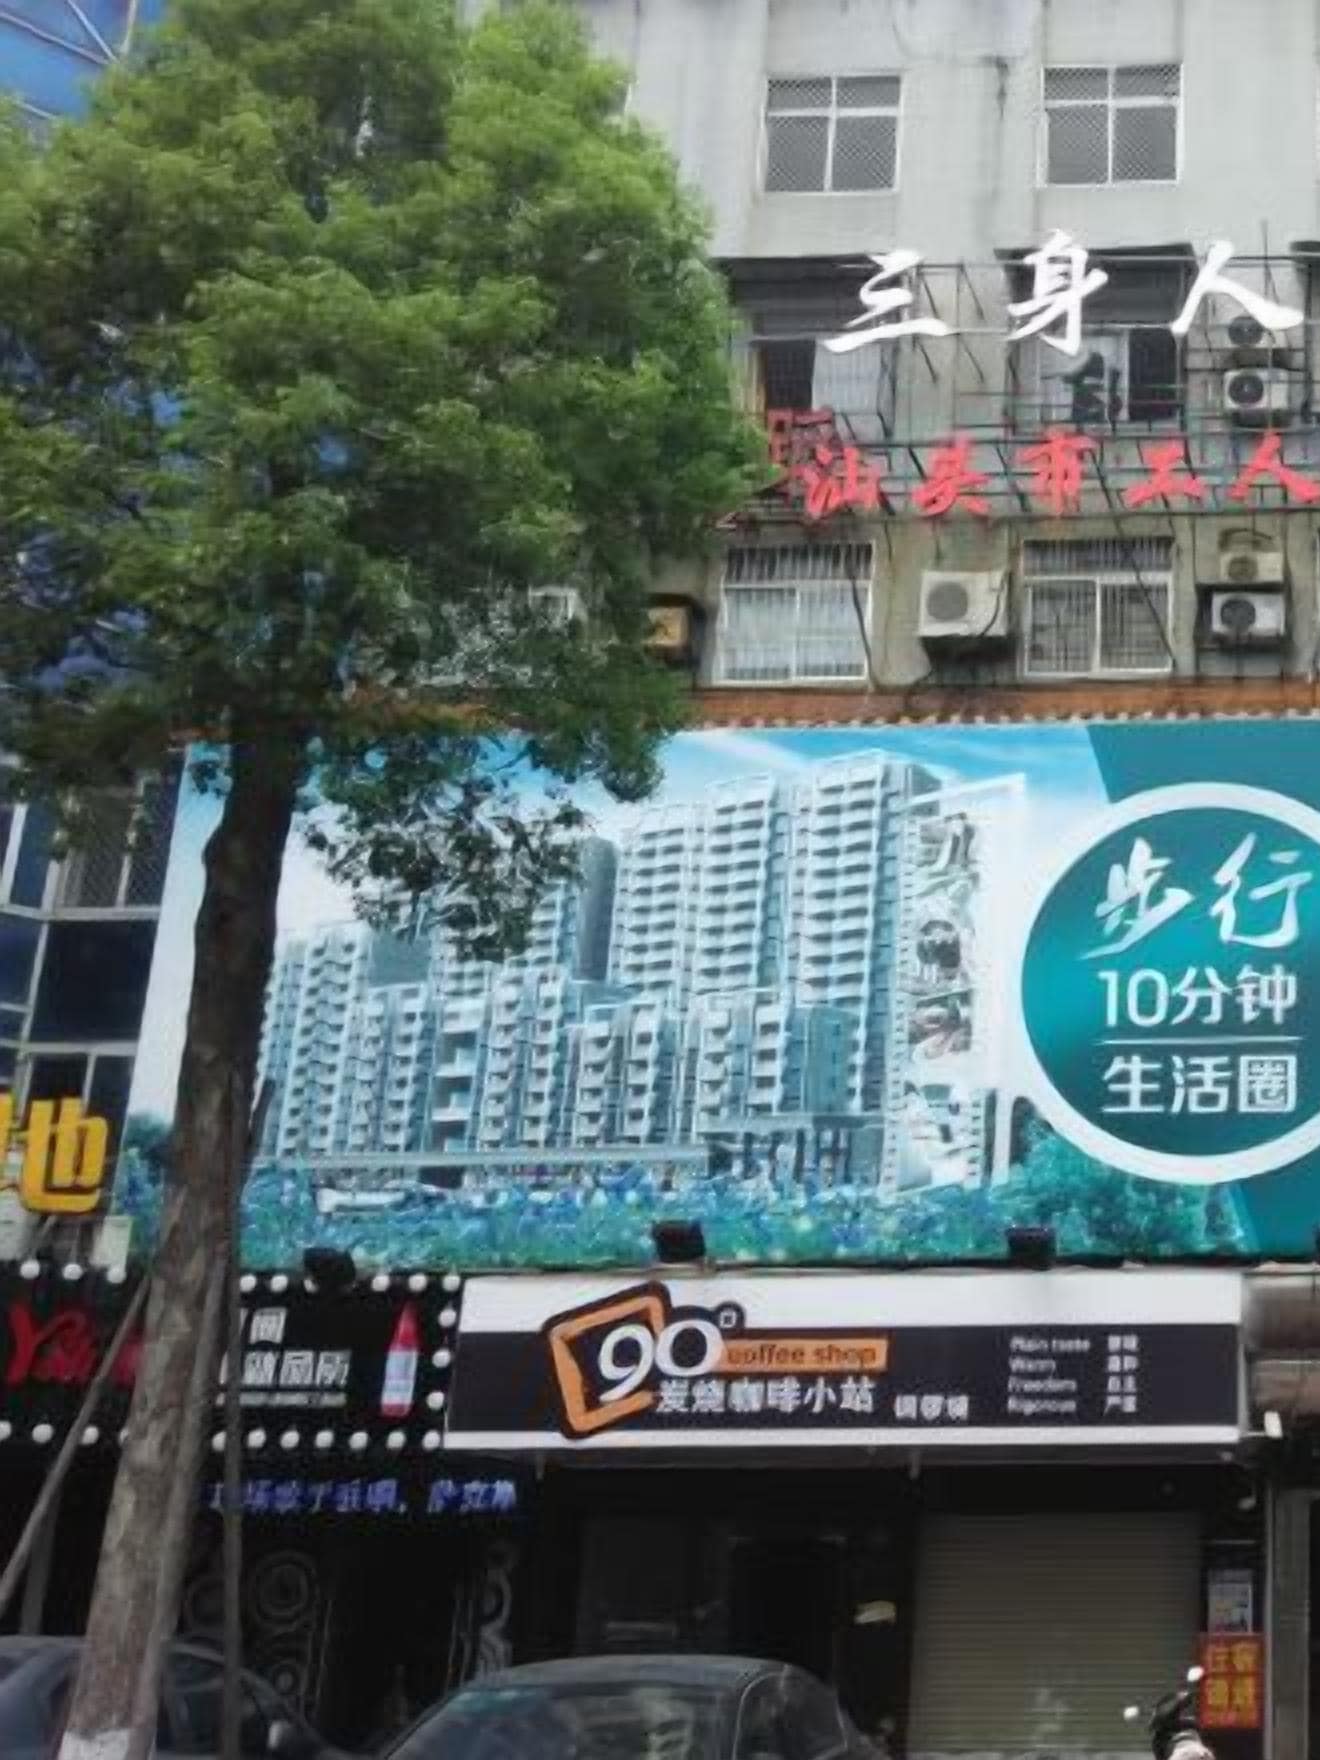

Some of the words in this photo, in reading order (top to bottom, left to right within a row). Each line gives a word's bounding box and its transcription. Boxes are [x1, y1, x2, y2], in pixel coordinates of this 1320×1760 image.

[1079, 832, 1313, 959] 步行
[1098, 964, 1297, 1027] 10分钟
[1102, 1054, 1298, 1115] 生活圈
